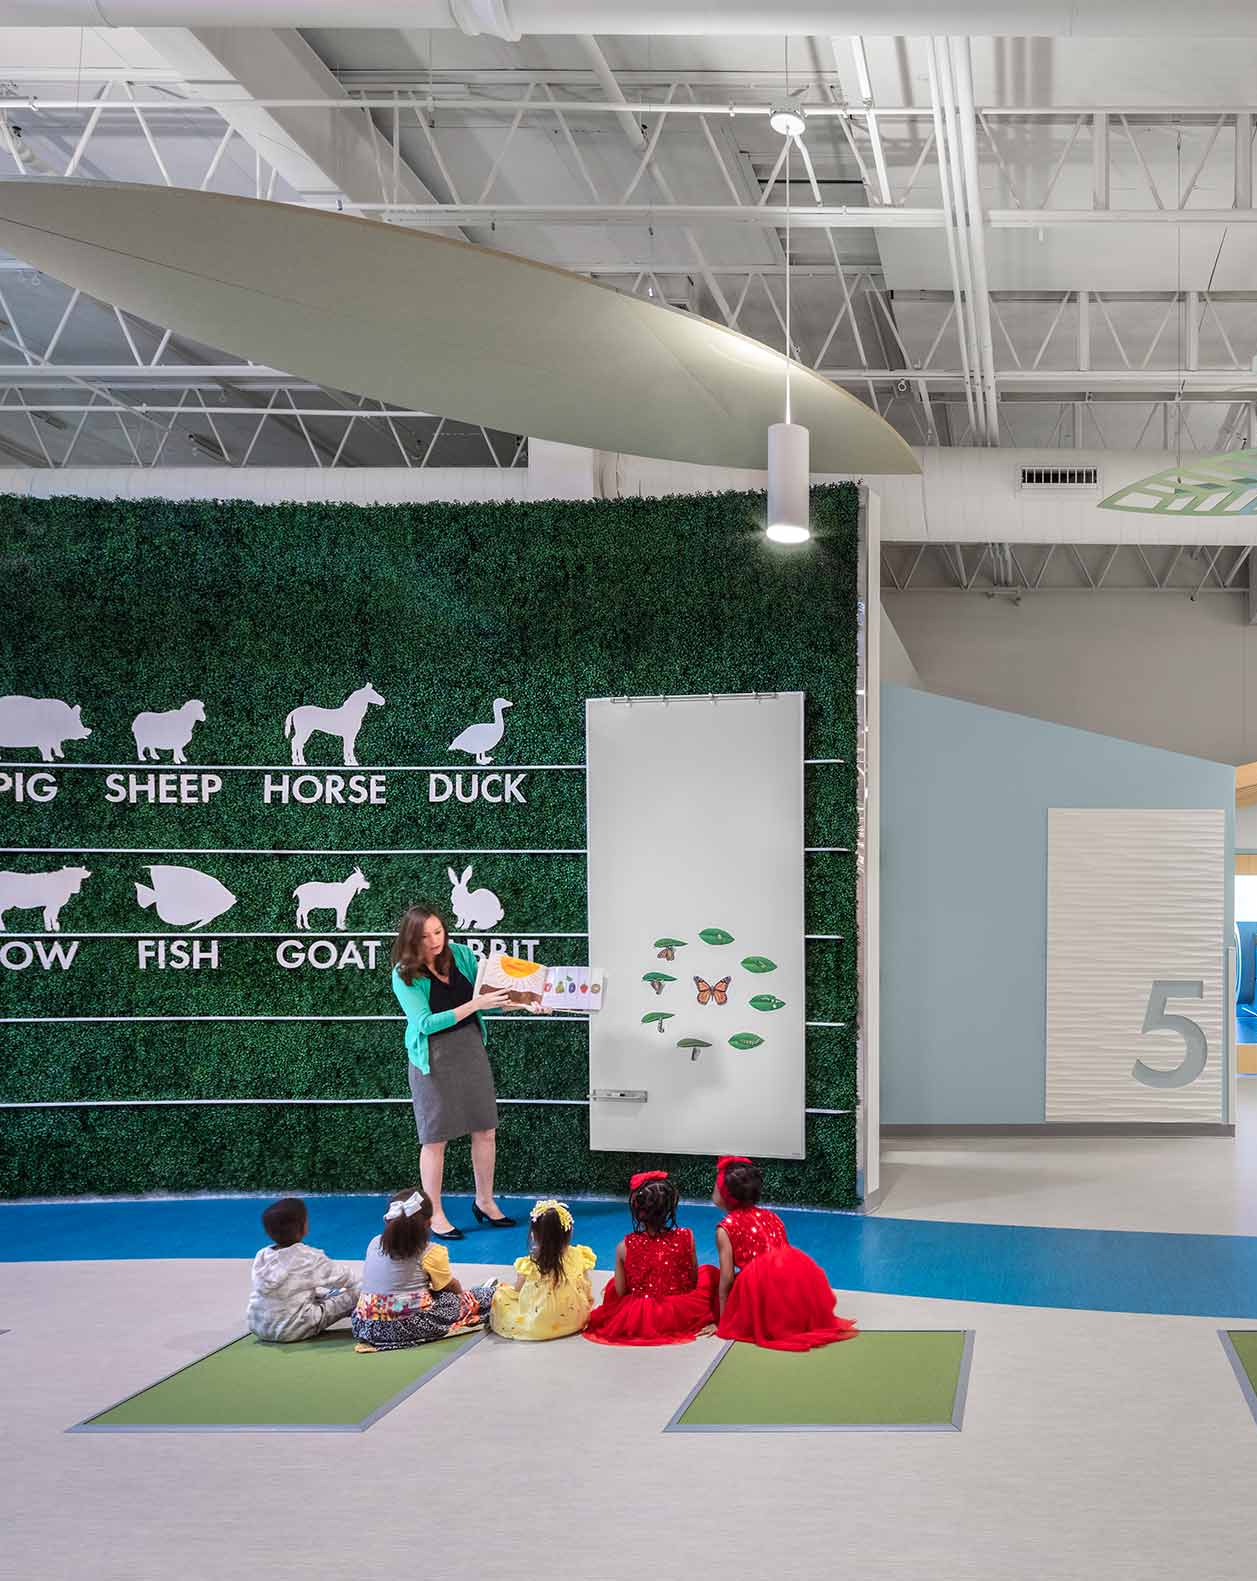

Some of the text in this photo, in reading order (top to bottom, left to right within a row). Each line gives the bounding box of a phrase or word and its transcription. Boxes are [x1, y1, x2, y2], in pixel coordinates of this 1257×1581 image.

[104, 773, 223, 804] SHEEP
[263, 774, 387, 804] HORSE
[428, 774, 527, 804] DUCK
[0, 940, 79, 970] OW
[138, 940, 219, 970] FISH
[276, 940, 378, 970] GOAT
[1132, 980, 1208, 1089] 5
